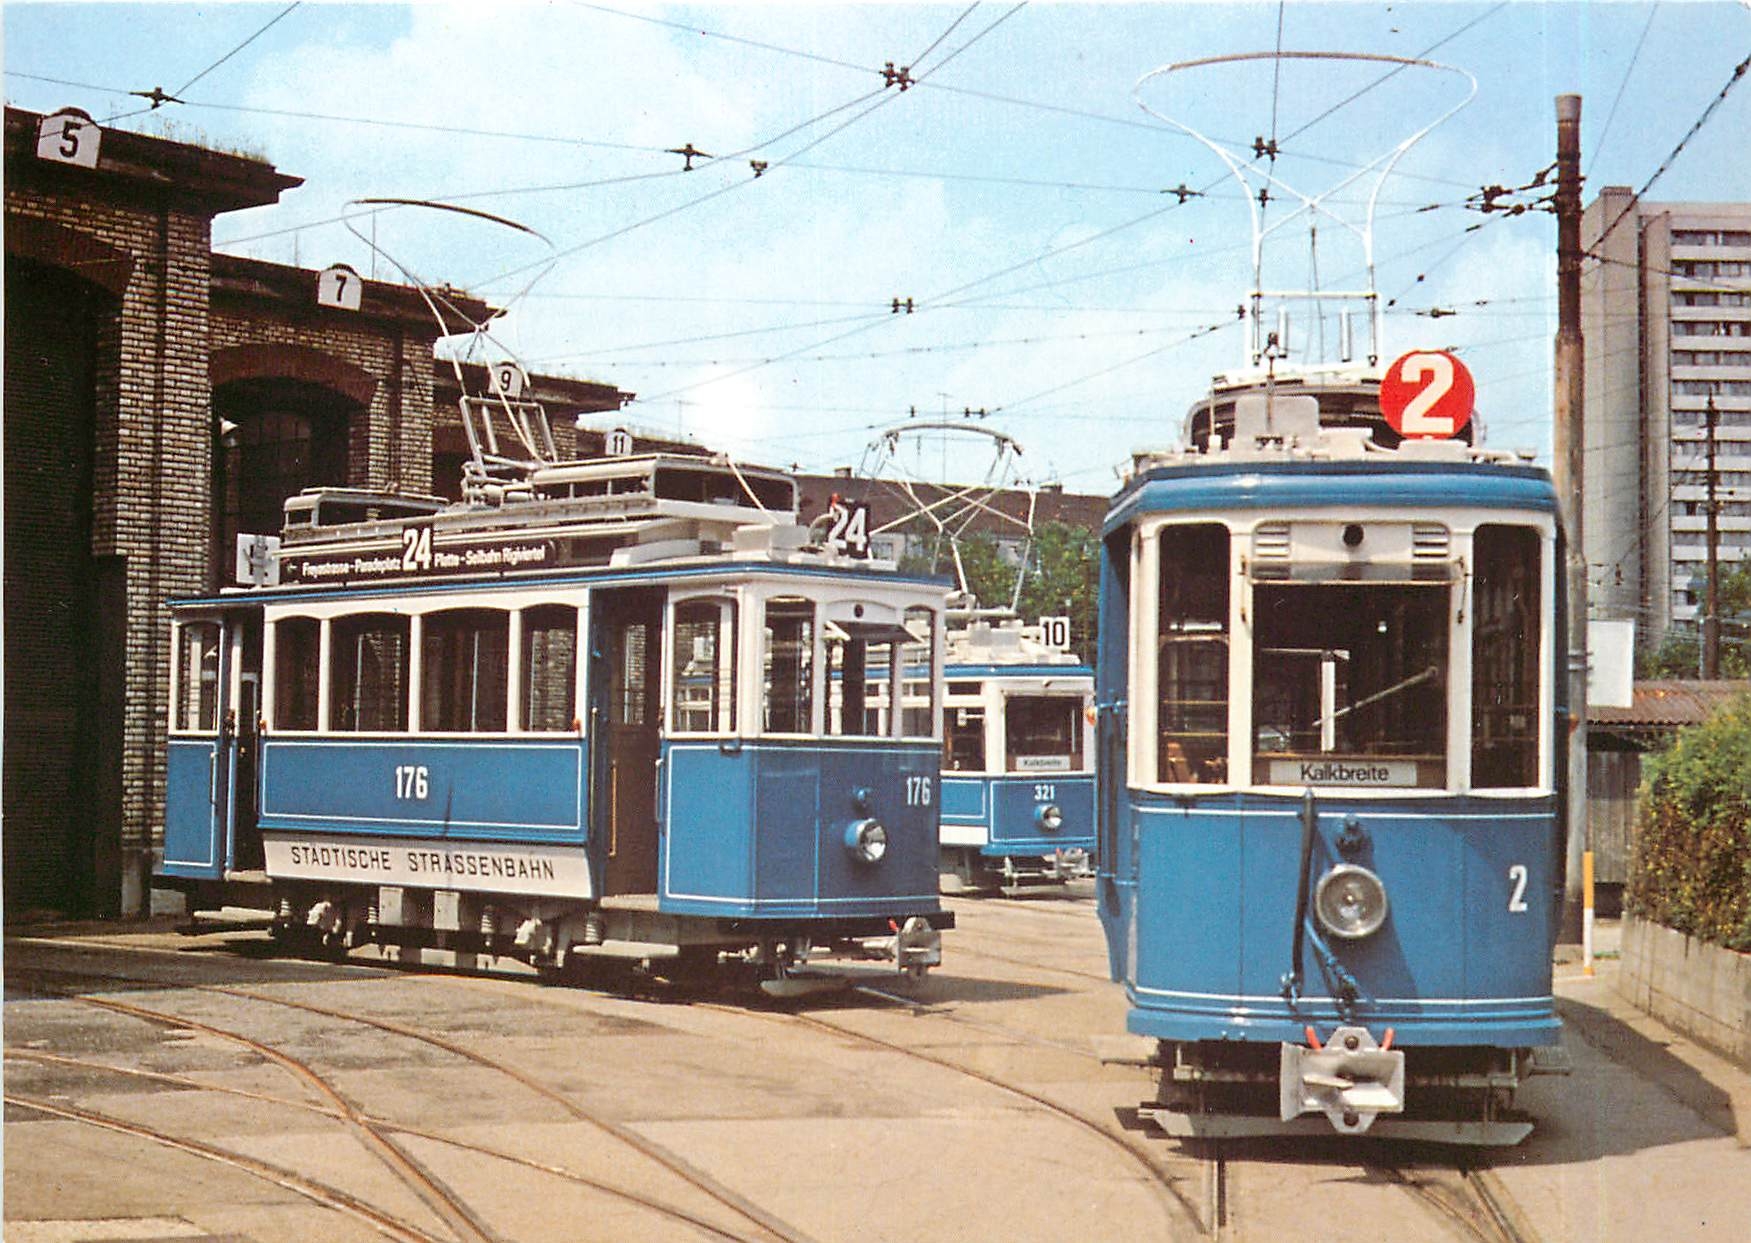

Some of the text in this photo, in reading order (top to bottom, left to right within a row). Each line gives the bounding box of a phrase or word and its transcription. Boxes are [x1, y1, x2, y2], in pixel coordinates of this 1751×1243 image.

[59, 120, 82, 158] 5
[336, 273, 347, 302] 7
[501, 370, 511, 391] 9
[1401, 353, 1454, 433] 2
[613, 434, 625, 454] 11
[828, 503, 867, 551] 24
[403, 527, 432, 571] 24
[1043, 621, 1065, 646] 10
[396, 766, 428, 799] 176
[1300, 763, 1390, 781] Kalkbreite
[906, 776, 931, 806] 176
[1034, 784, 1055, 800] 321
[407, 852, 555, 880] STRASSENBAHN
[1509, 864, 1528, 912] 2
